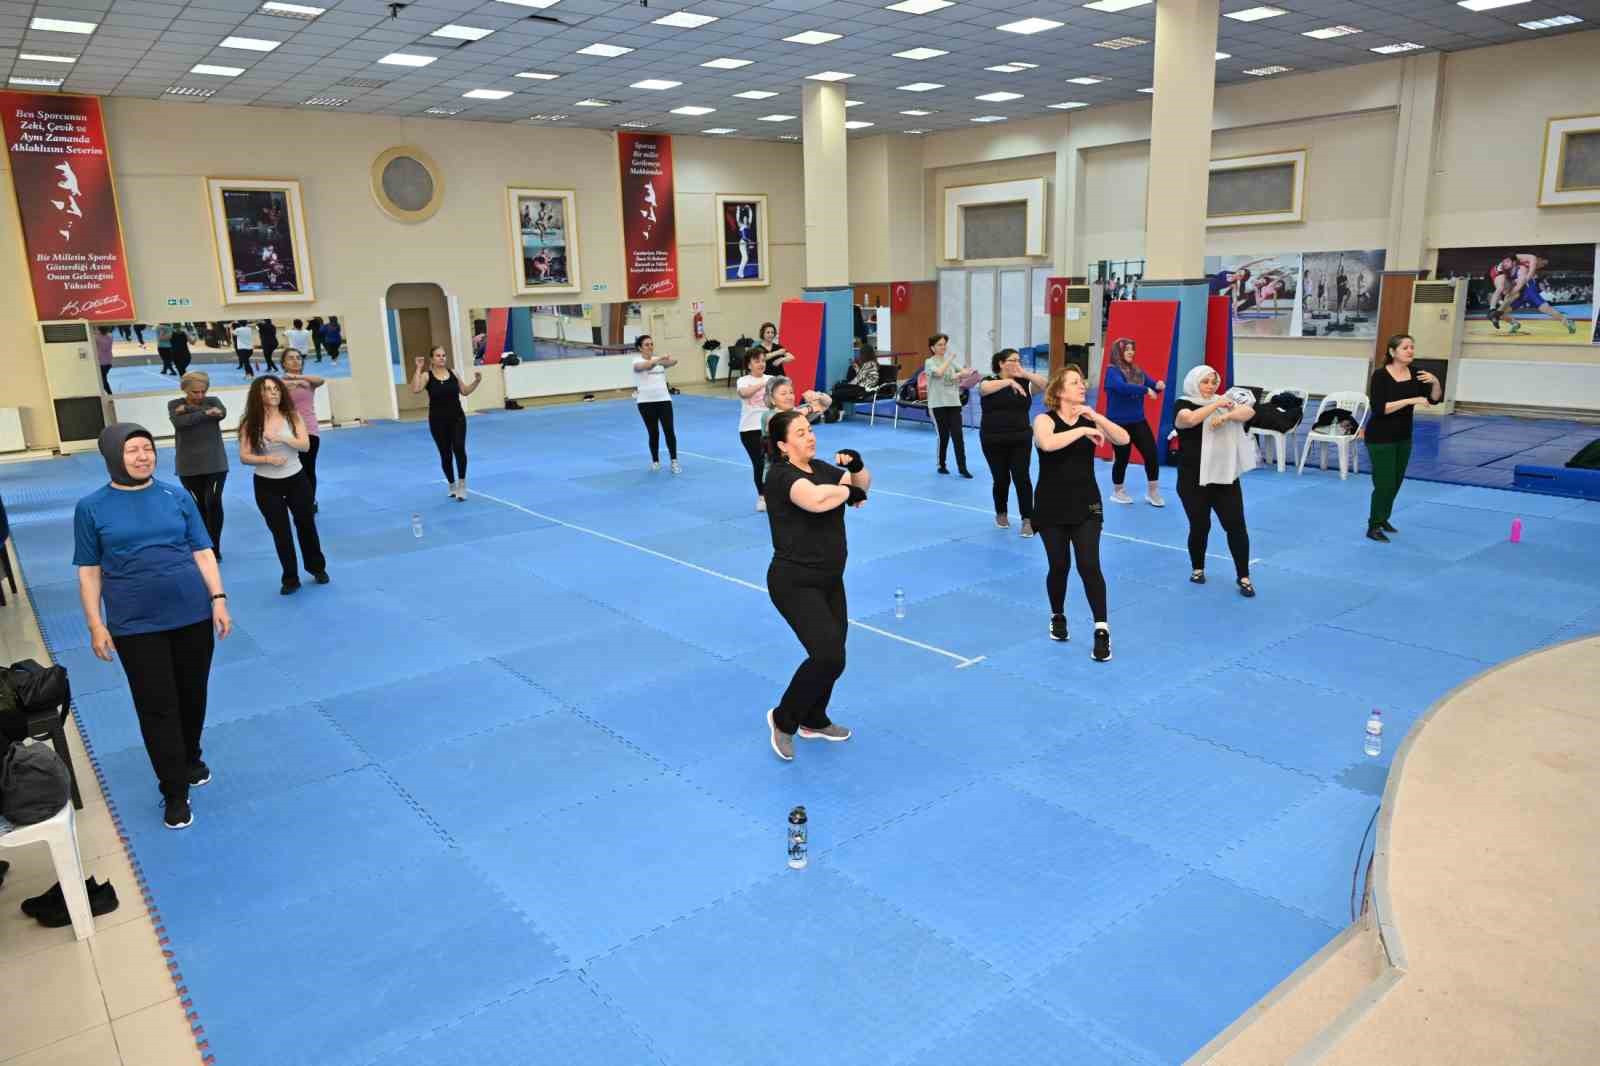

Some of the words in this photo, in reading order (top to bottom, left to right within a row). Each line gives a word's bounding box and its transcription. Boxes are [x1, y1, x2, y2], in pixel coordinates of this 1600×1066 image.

[16, 109, 34, 118] Ben
[36, 110, 87, 121] Sporcunun
[20, 121, 45, 131] Zeki,
[47, 122, 74, 132] Çevik
[45, 133, 91, 143] Zamanda
